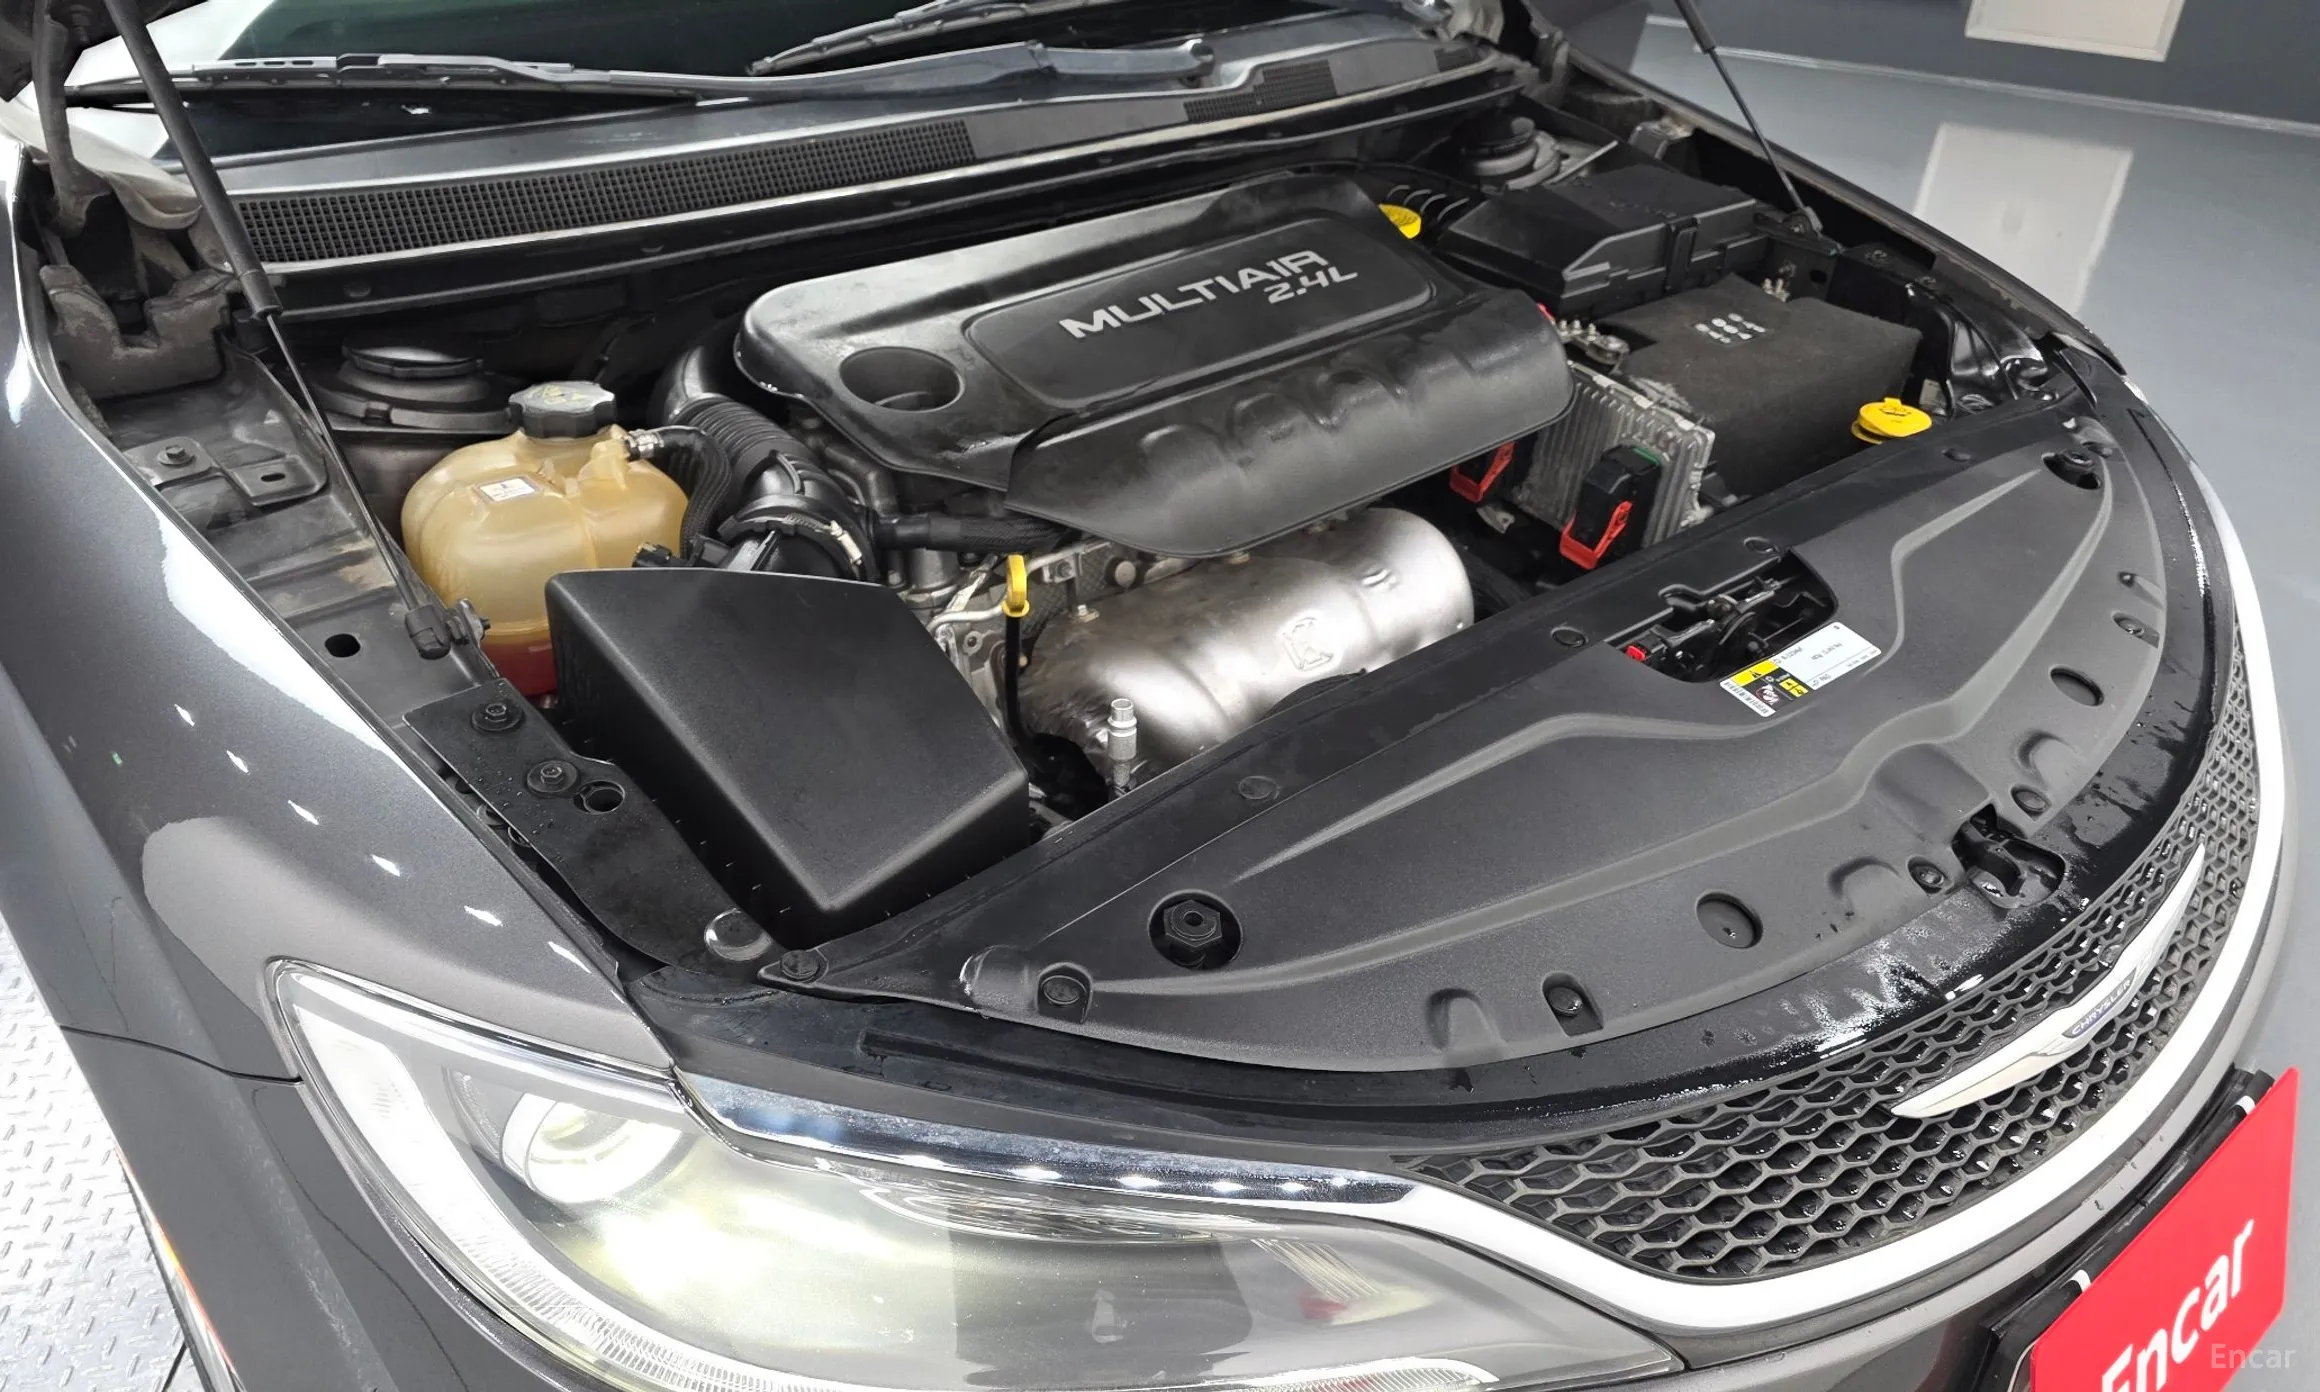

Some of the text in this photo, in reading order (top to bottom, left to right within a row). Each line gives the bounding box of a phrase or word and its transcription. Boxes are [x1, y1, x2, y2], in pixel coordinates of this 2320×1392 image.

[1059, 250, 1329, 338] MULTIAIR
[1264, 267, 1358, 303] 2.4L
[2071, 980, 2130, 1035] CHRYSLER
